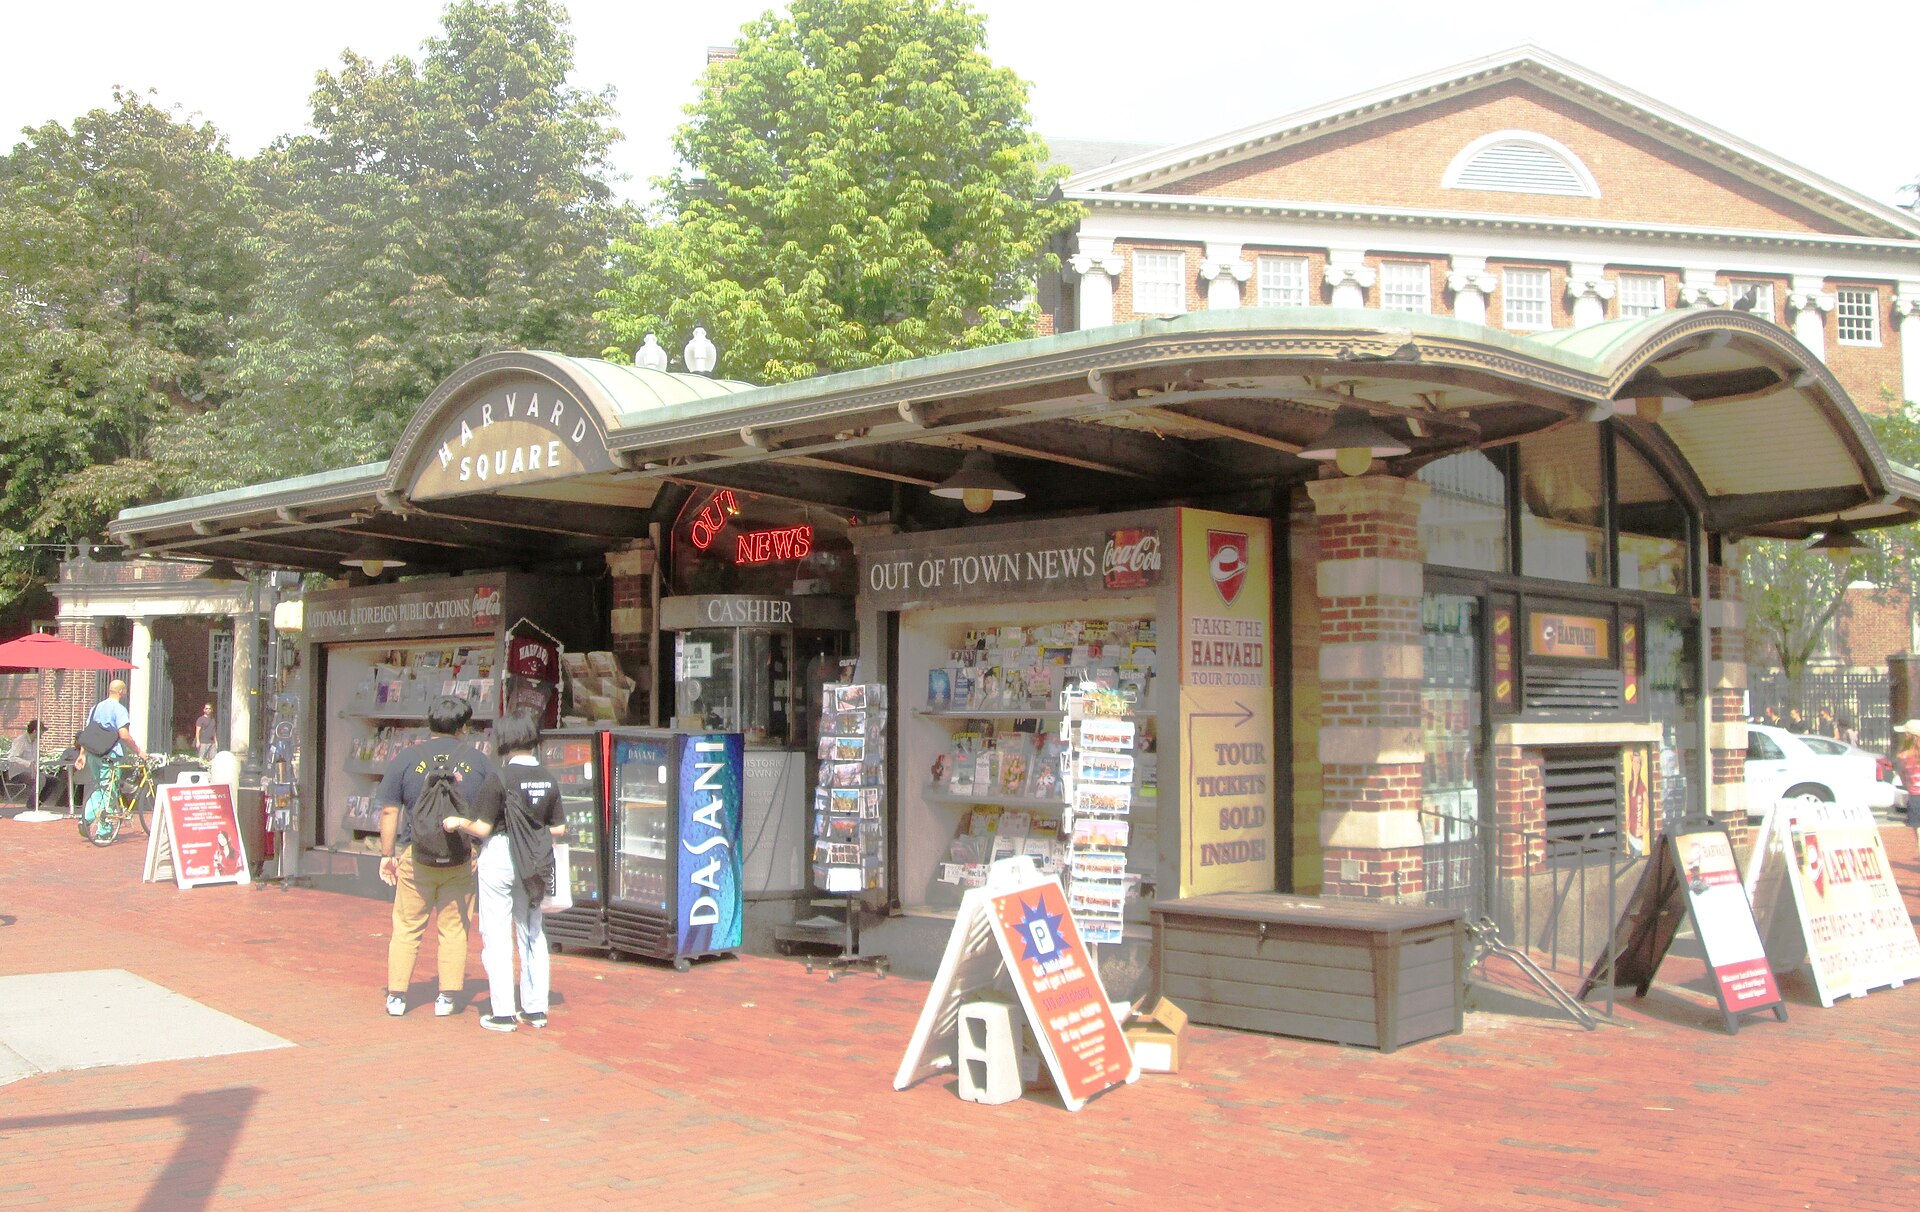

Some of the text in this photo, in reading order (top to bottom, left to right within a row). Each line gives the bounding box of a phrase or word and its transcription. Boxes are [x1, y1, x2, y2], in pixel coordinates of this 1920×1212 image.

[438, 392, 586, 471] HARVARD
[459, 440, 560, 481] SQUARE
[692, 490, 737, 549] OUT
[736, 526, 810, 563] NEWS
[870, 546, 1096, 591] OUT OF TOWN NEWS
[357, 605, 398, 624] FOREIGN
[400, 598, 470, 622] PUBLICATIONS
[708, 599, 793, 623] CASHIER
[1191, 617, 1262, 637] TAKE THE
[1191, 640, 1263, 667] HARVARD
[1191, 672, 1265, 686] TOUR TODAY
[1215, 742, 1266, 766] TOUR
[1196, 775, 1266, 797] TICKETS
[1219, 806, 1265, 830] SOLD
[683, 743, 730, 926] DASANI
[1200, 839, 1266, 867] INSIDE!
